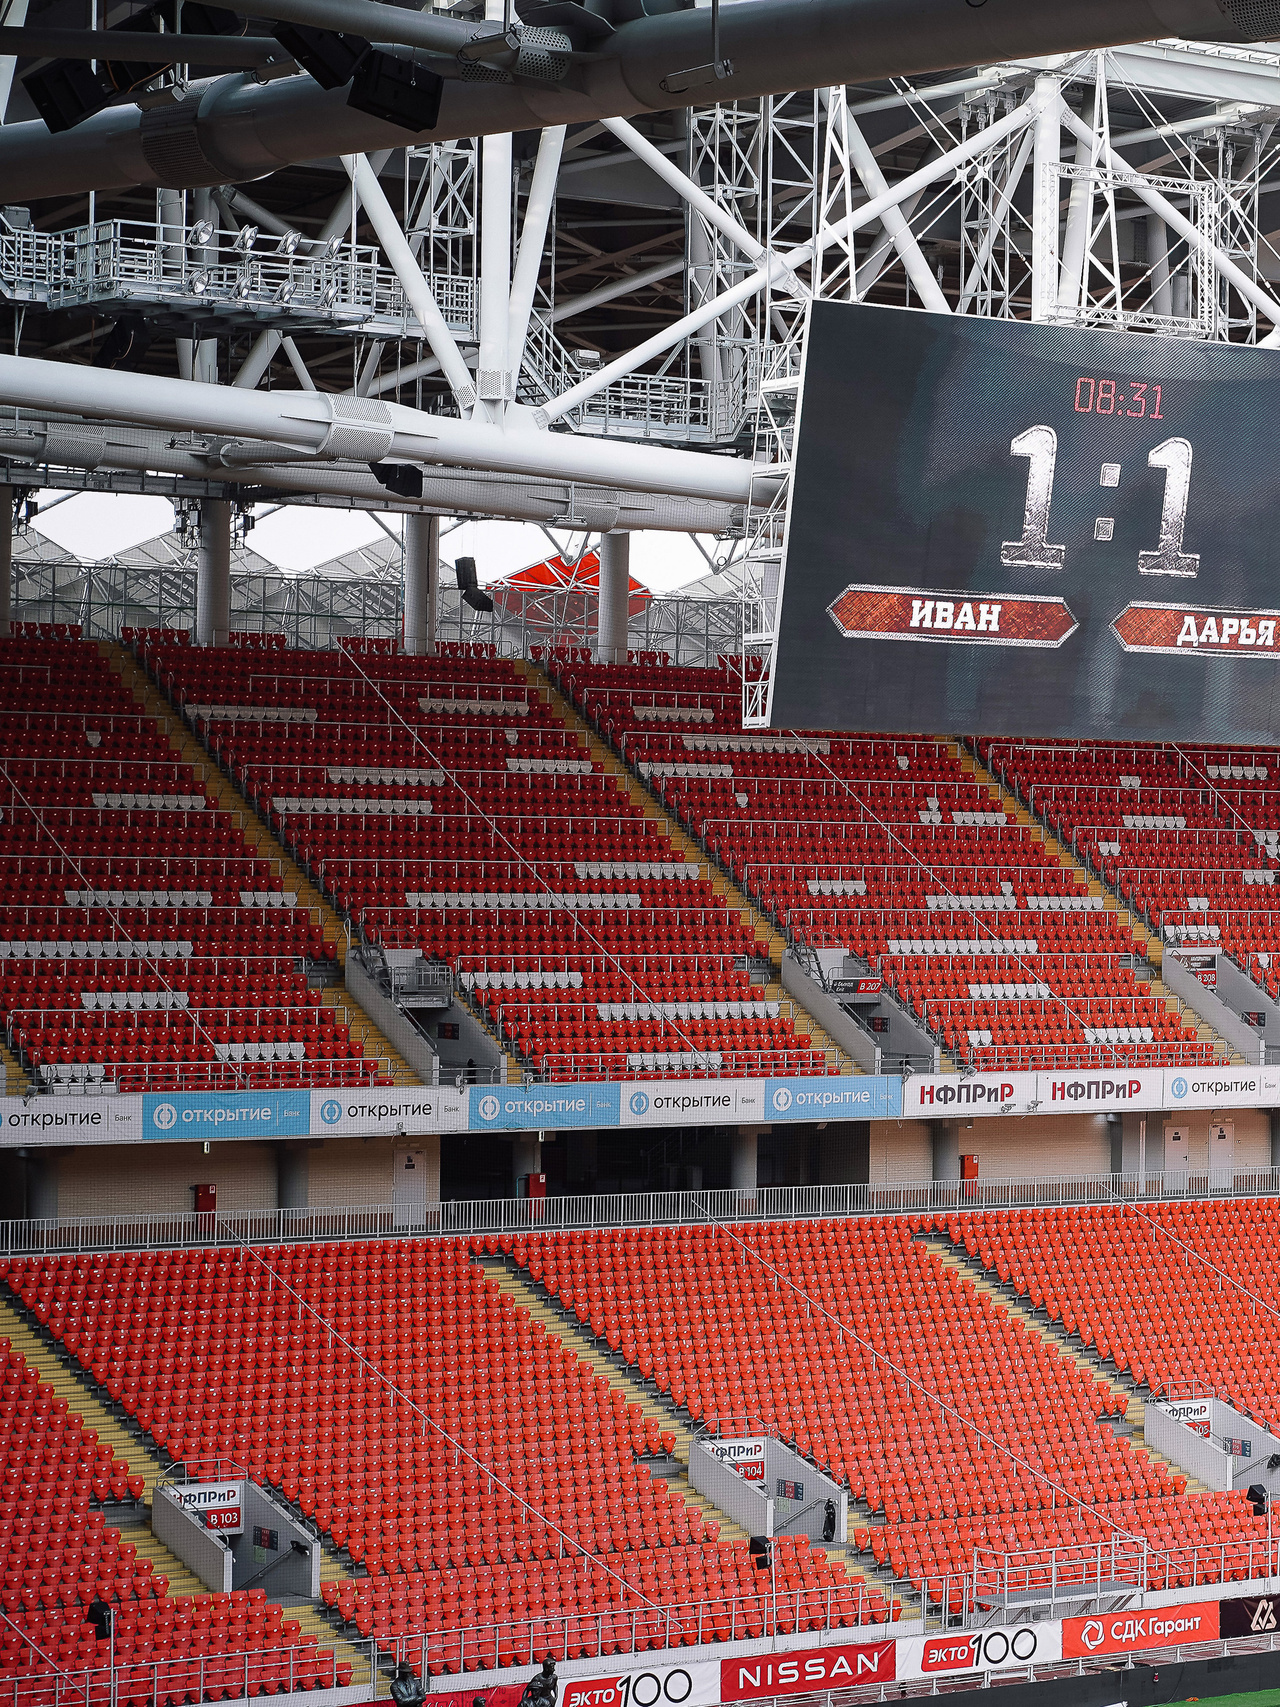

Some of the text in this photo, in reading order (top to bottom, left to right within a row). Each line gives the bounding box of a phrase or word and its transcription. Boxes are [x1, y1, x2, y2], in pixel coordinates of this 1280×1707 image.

[1074, 377, 1164, 420] 08:31
[910, 599, 1002, 632] ИВАН
[1176, 614, 1276, 648] ДАРЬЯ
[1203, 974, 1216, 982] 208
[1192, 1079, 1256, 1096] открытие
[504, 1099, 586, 1117] открытие
[654, 1094, 731, 1112] открытие
[796, 1090, 870, 1108] открытие
[8, 1111, 102, 1130] открытие
[182, 1106, 272, 1126] открытие
[347, 1104, 432, 1121] открытие
[746, 1465, 762, 1476] 104
[220, 1512, 238, 1523] 103
[1111, 1616, 1201, 1643] СДК Гарант
[738, 1652, 879, 1690] NISSAN
